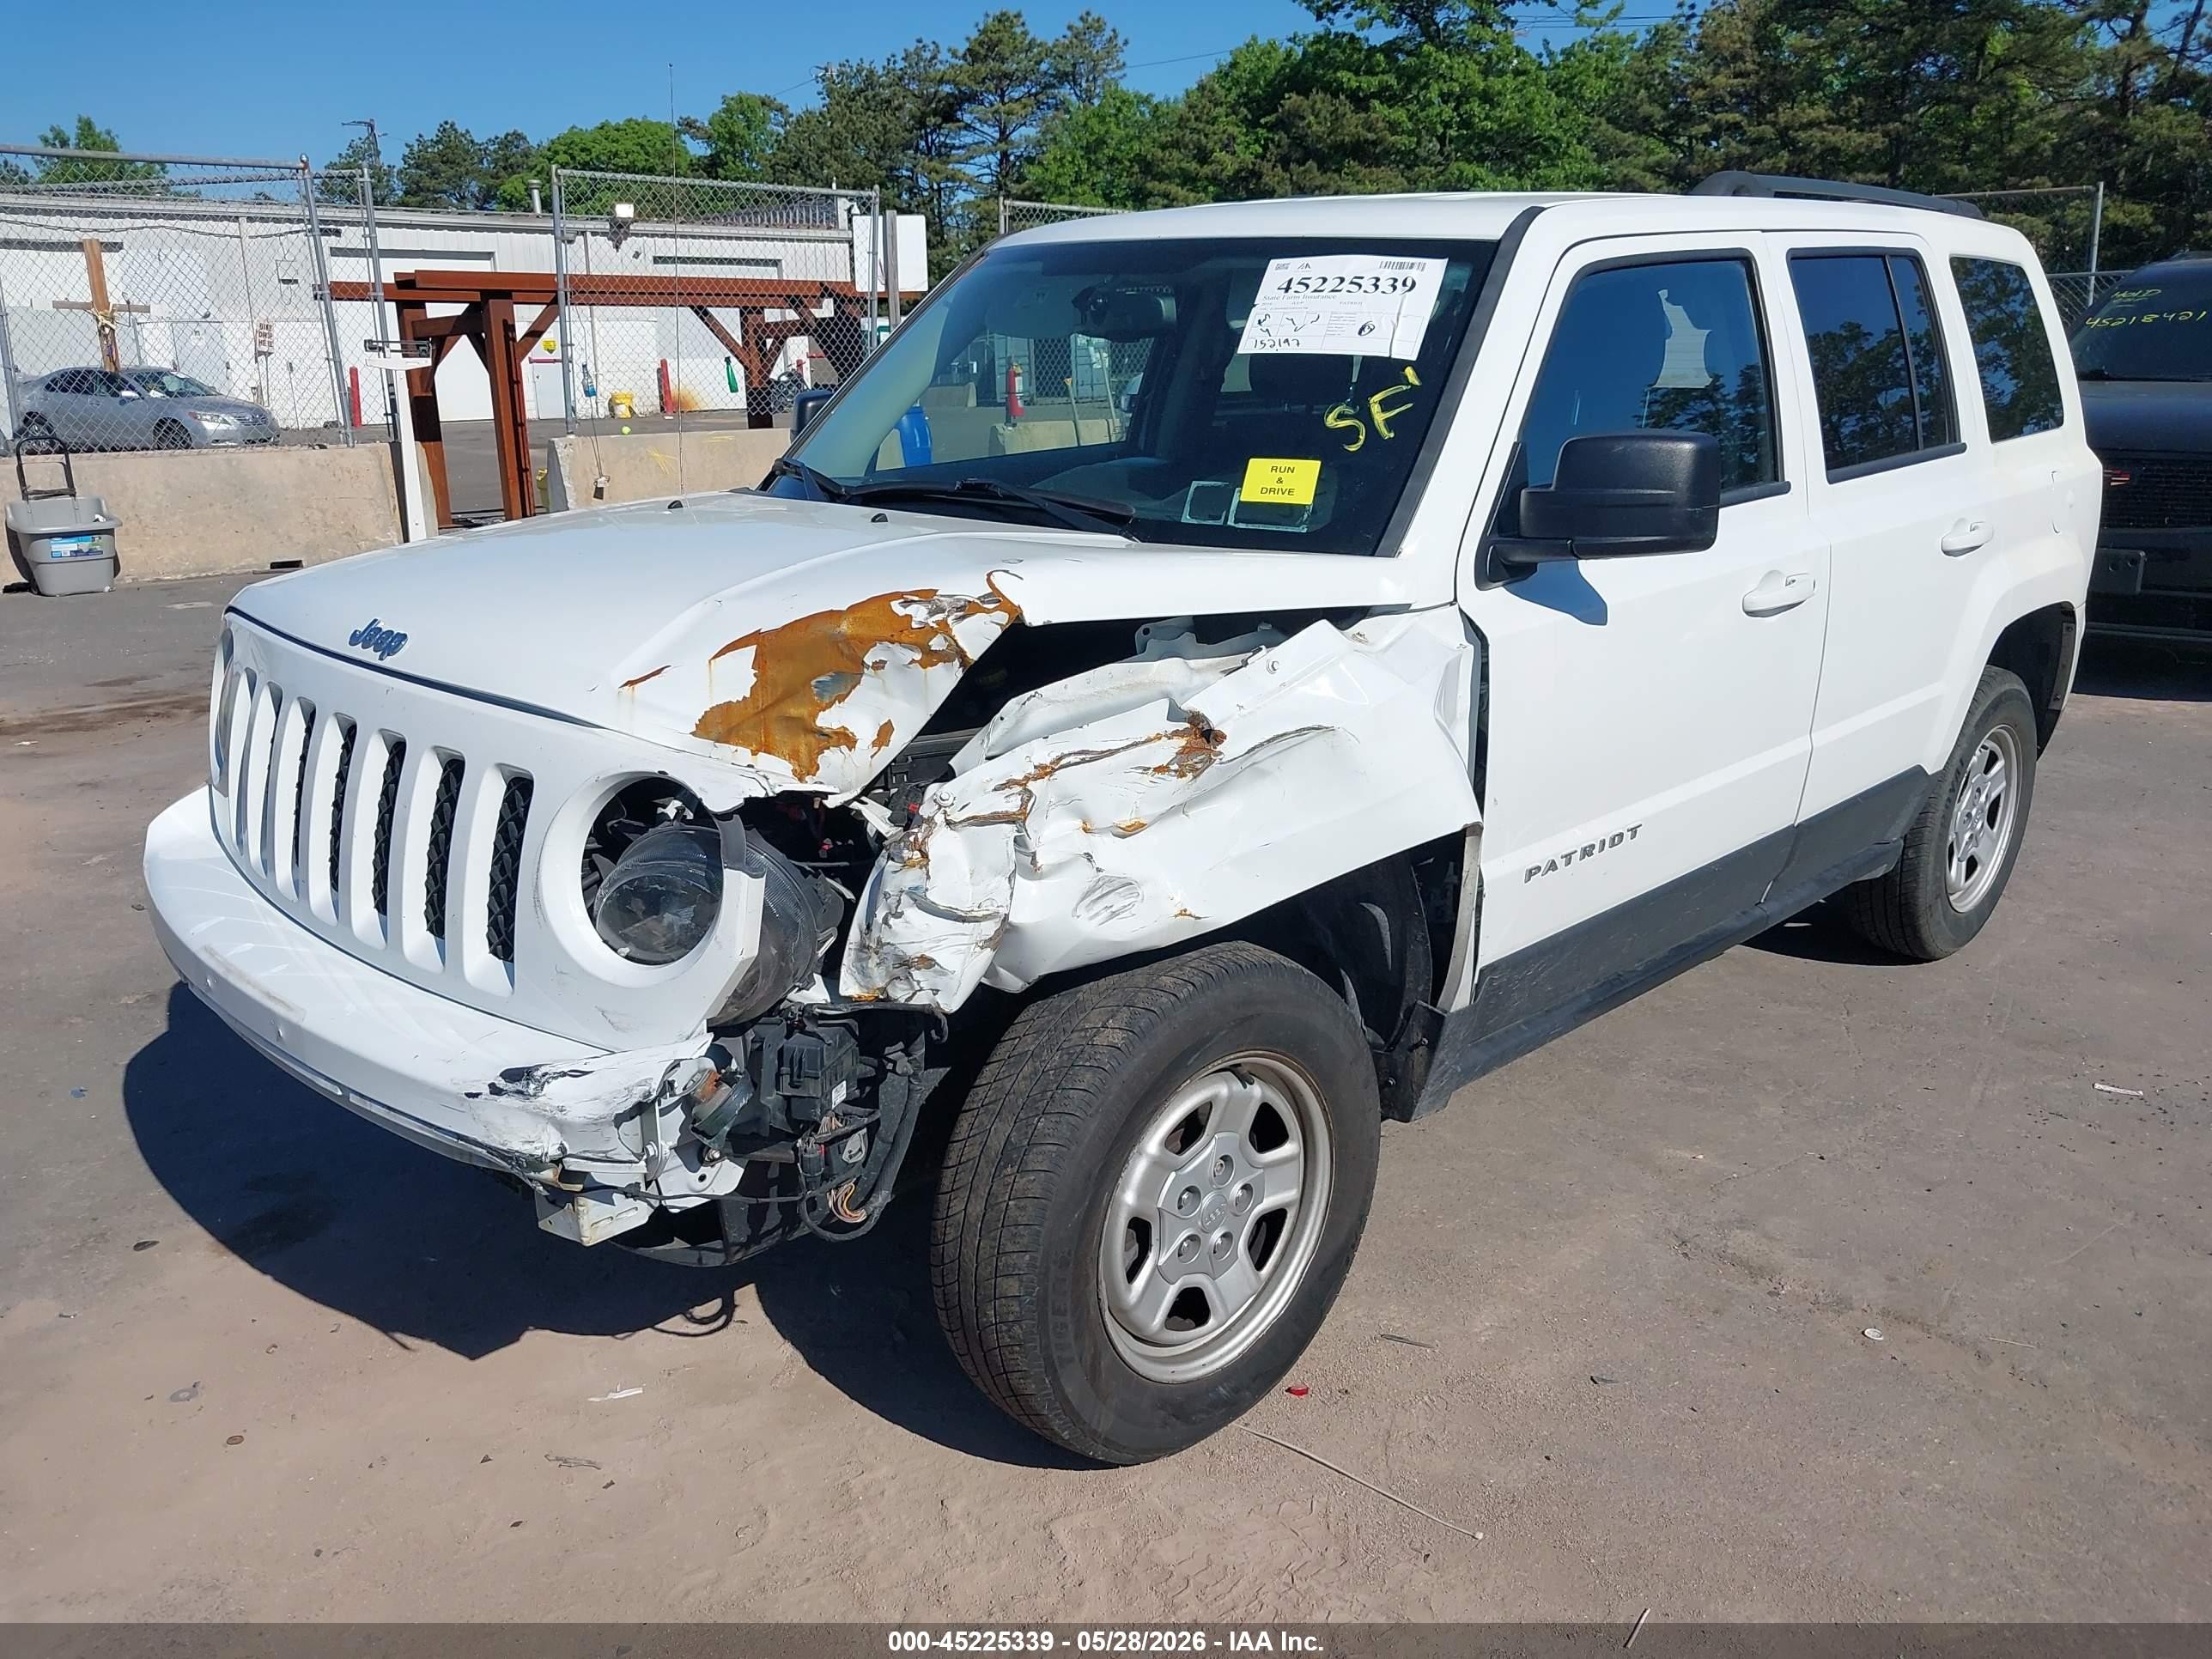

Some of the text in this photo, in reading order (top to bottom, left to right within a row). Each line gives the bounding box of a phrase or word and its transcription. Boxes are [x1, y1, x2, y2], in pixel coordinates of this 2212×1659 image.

[1277, 276, 1418, 295] 45225339
[1270, 465, 1295, 474] RUN
[1260, 487, 1296, 496] DRIVE
[349, 618, 408, 661] Jeep
[1524, 823, 1643, 884] PATRIOT
